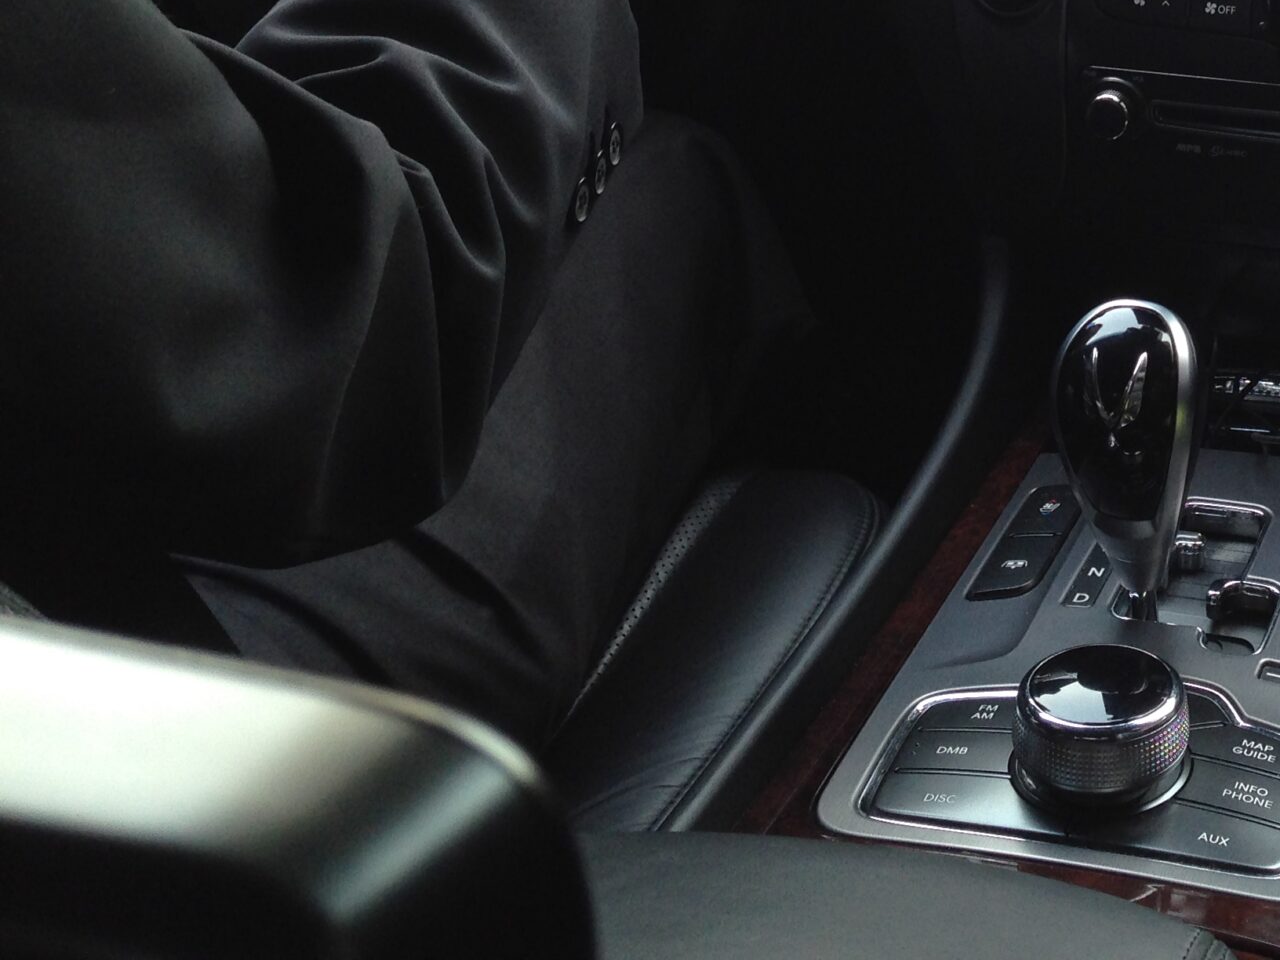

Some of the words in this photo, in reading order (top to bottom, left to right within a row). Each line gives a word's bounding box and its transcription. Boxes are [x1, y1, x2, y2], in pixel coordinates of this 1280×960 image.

[1218, 4, 1237, 15] OFF
[1088, 567, 1105, 577] N
[1072, 593, 1089, 603] D
[978, 704, 999, 712] FM
[971, 712, 994, 720] AM
[936, 746, 968, 755] DMB
[1242, 738, 1274, 752] MAP
[1232, 746, 1277, 763] GUIDE
[1234, 781, 1269, 797] INFO
[923, 793, 956, 804] DISC
[1222, 789, 1274, 809] PHONE
[1197, 832, 1230, 847] AUX
